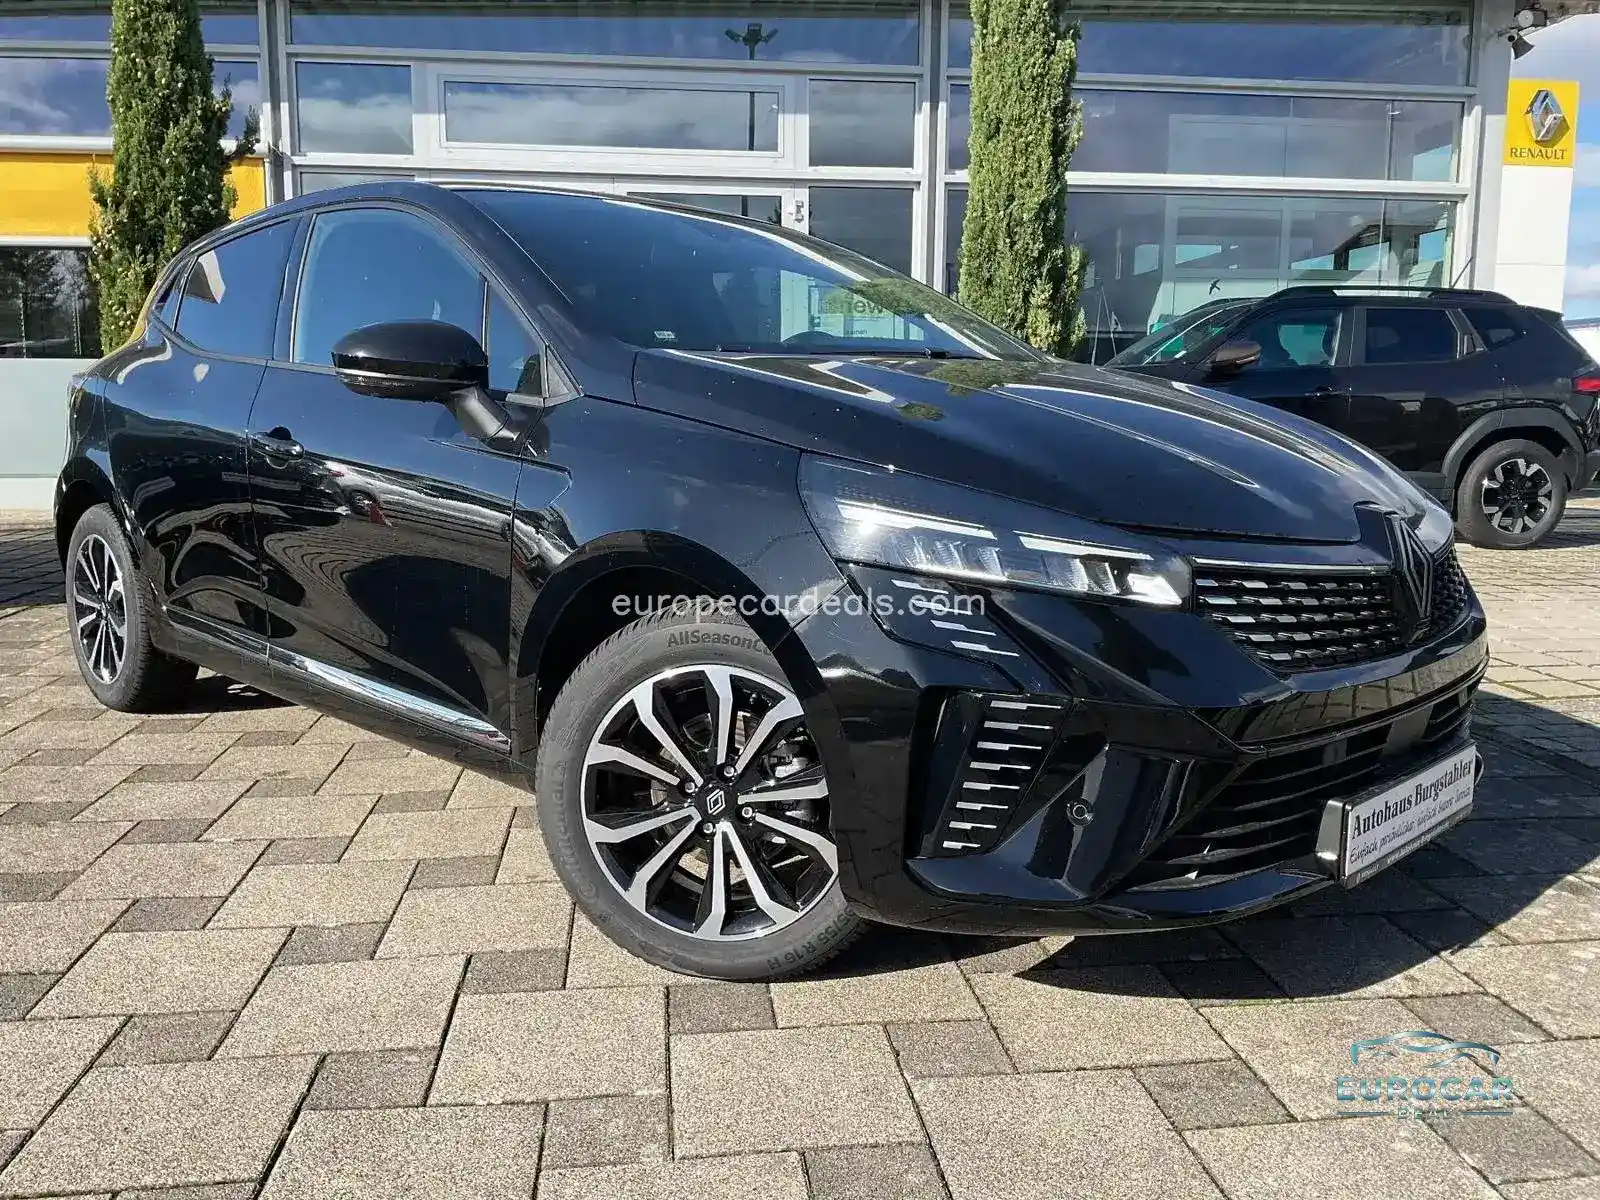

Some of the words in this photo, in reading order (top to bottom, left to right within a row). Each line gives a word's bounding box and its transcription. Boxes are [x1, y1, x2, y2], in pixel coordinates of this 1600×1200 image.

[1510, 147, 1568, 160] RENAULT
[1351, 793, 1413, 840] Autohaus
[1414, 760, 1473, 805] Burgstahler
